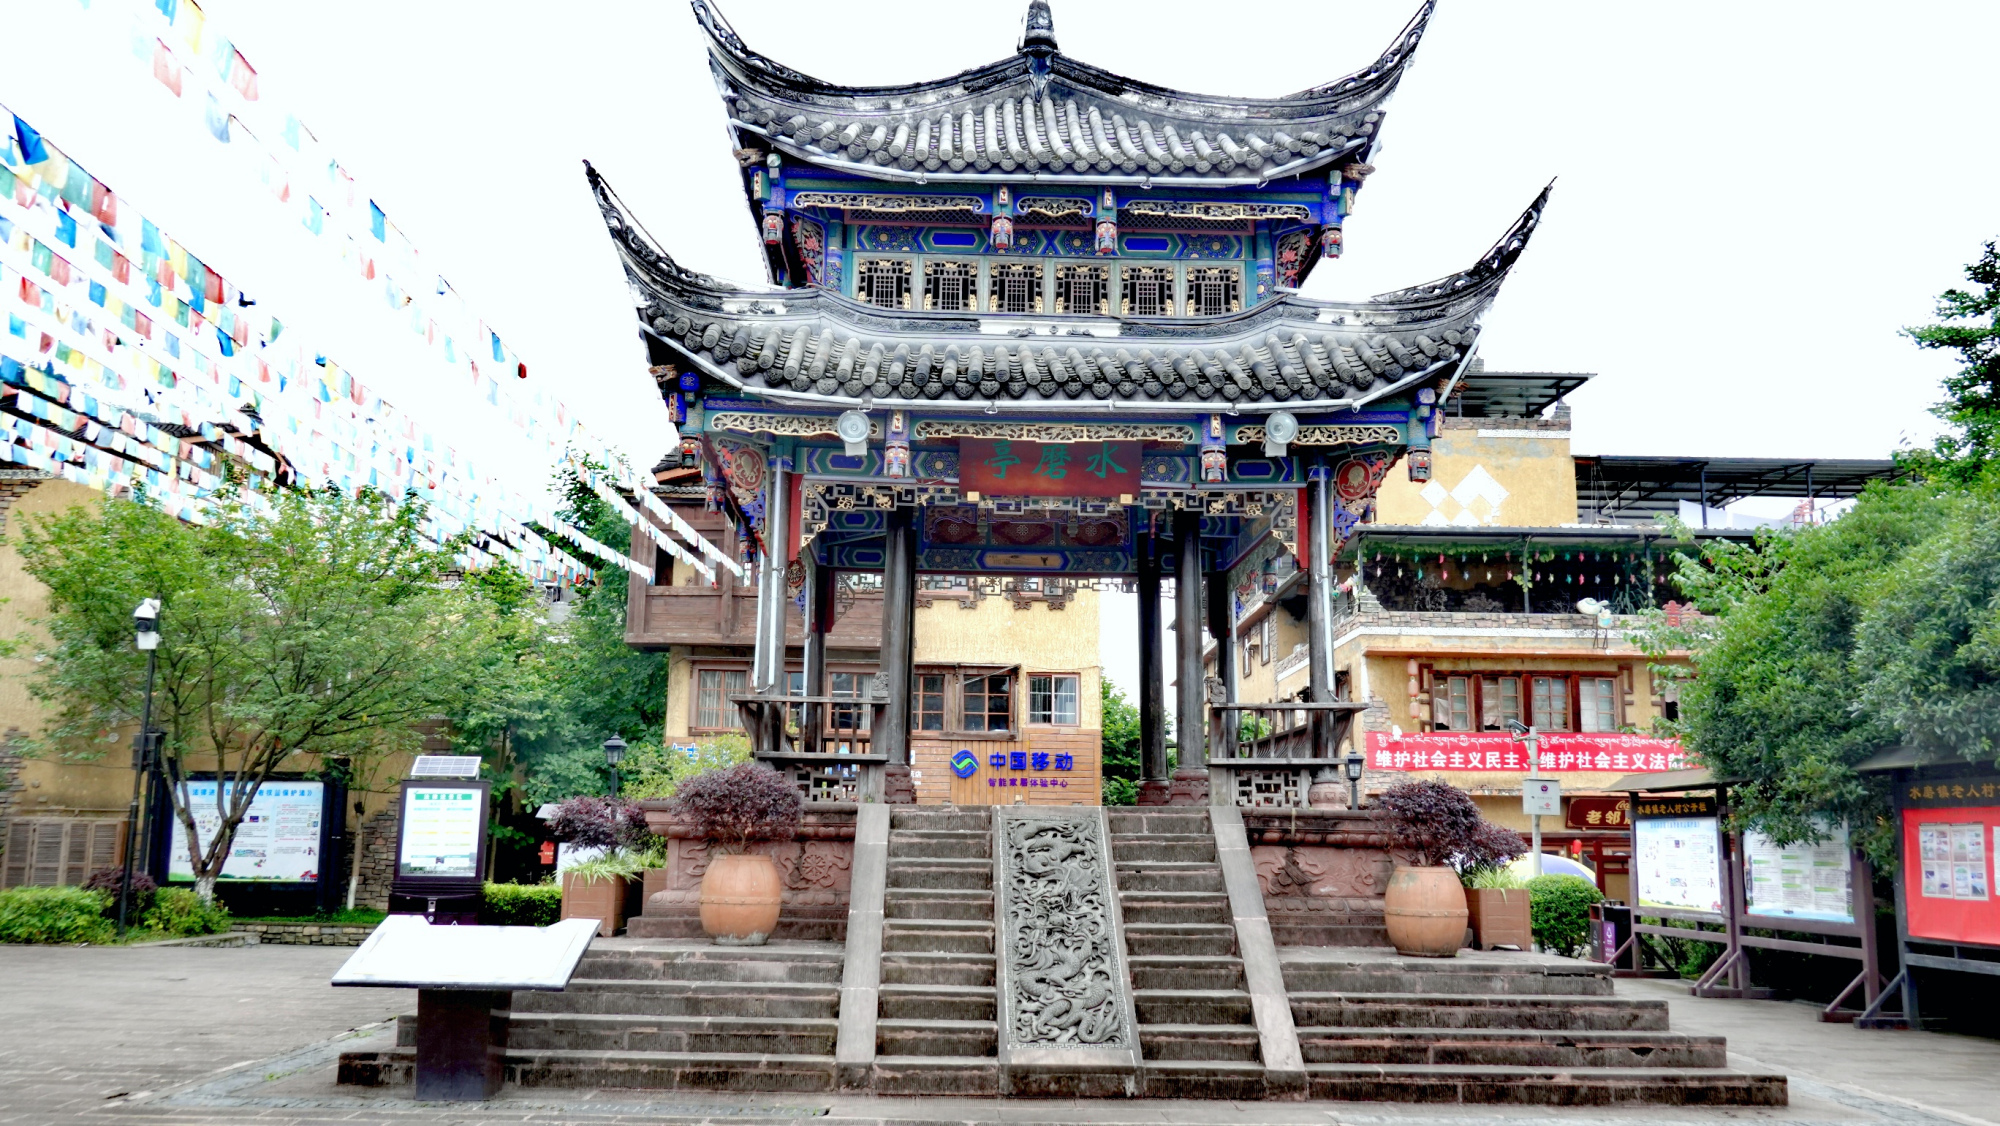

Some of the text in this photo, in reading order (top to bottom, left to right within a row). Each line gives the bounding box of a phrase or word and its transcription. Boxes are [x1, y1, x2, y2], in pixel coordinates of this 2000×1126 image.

[989, 751, 1073, 771] 中国移动
[988, 778, 1068, 788] 智能家居体验中心
